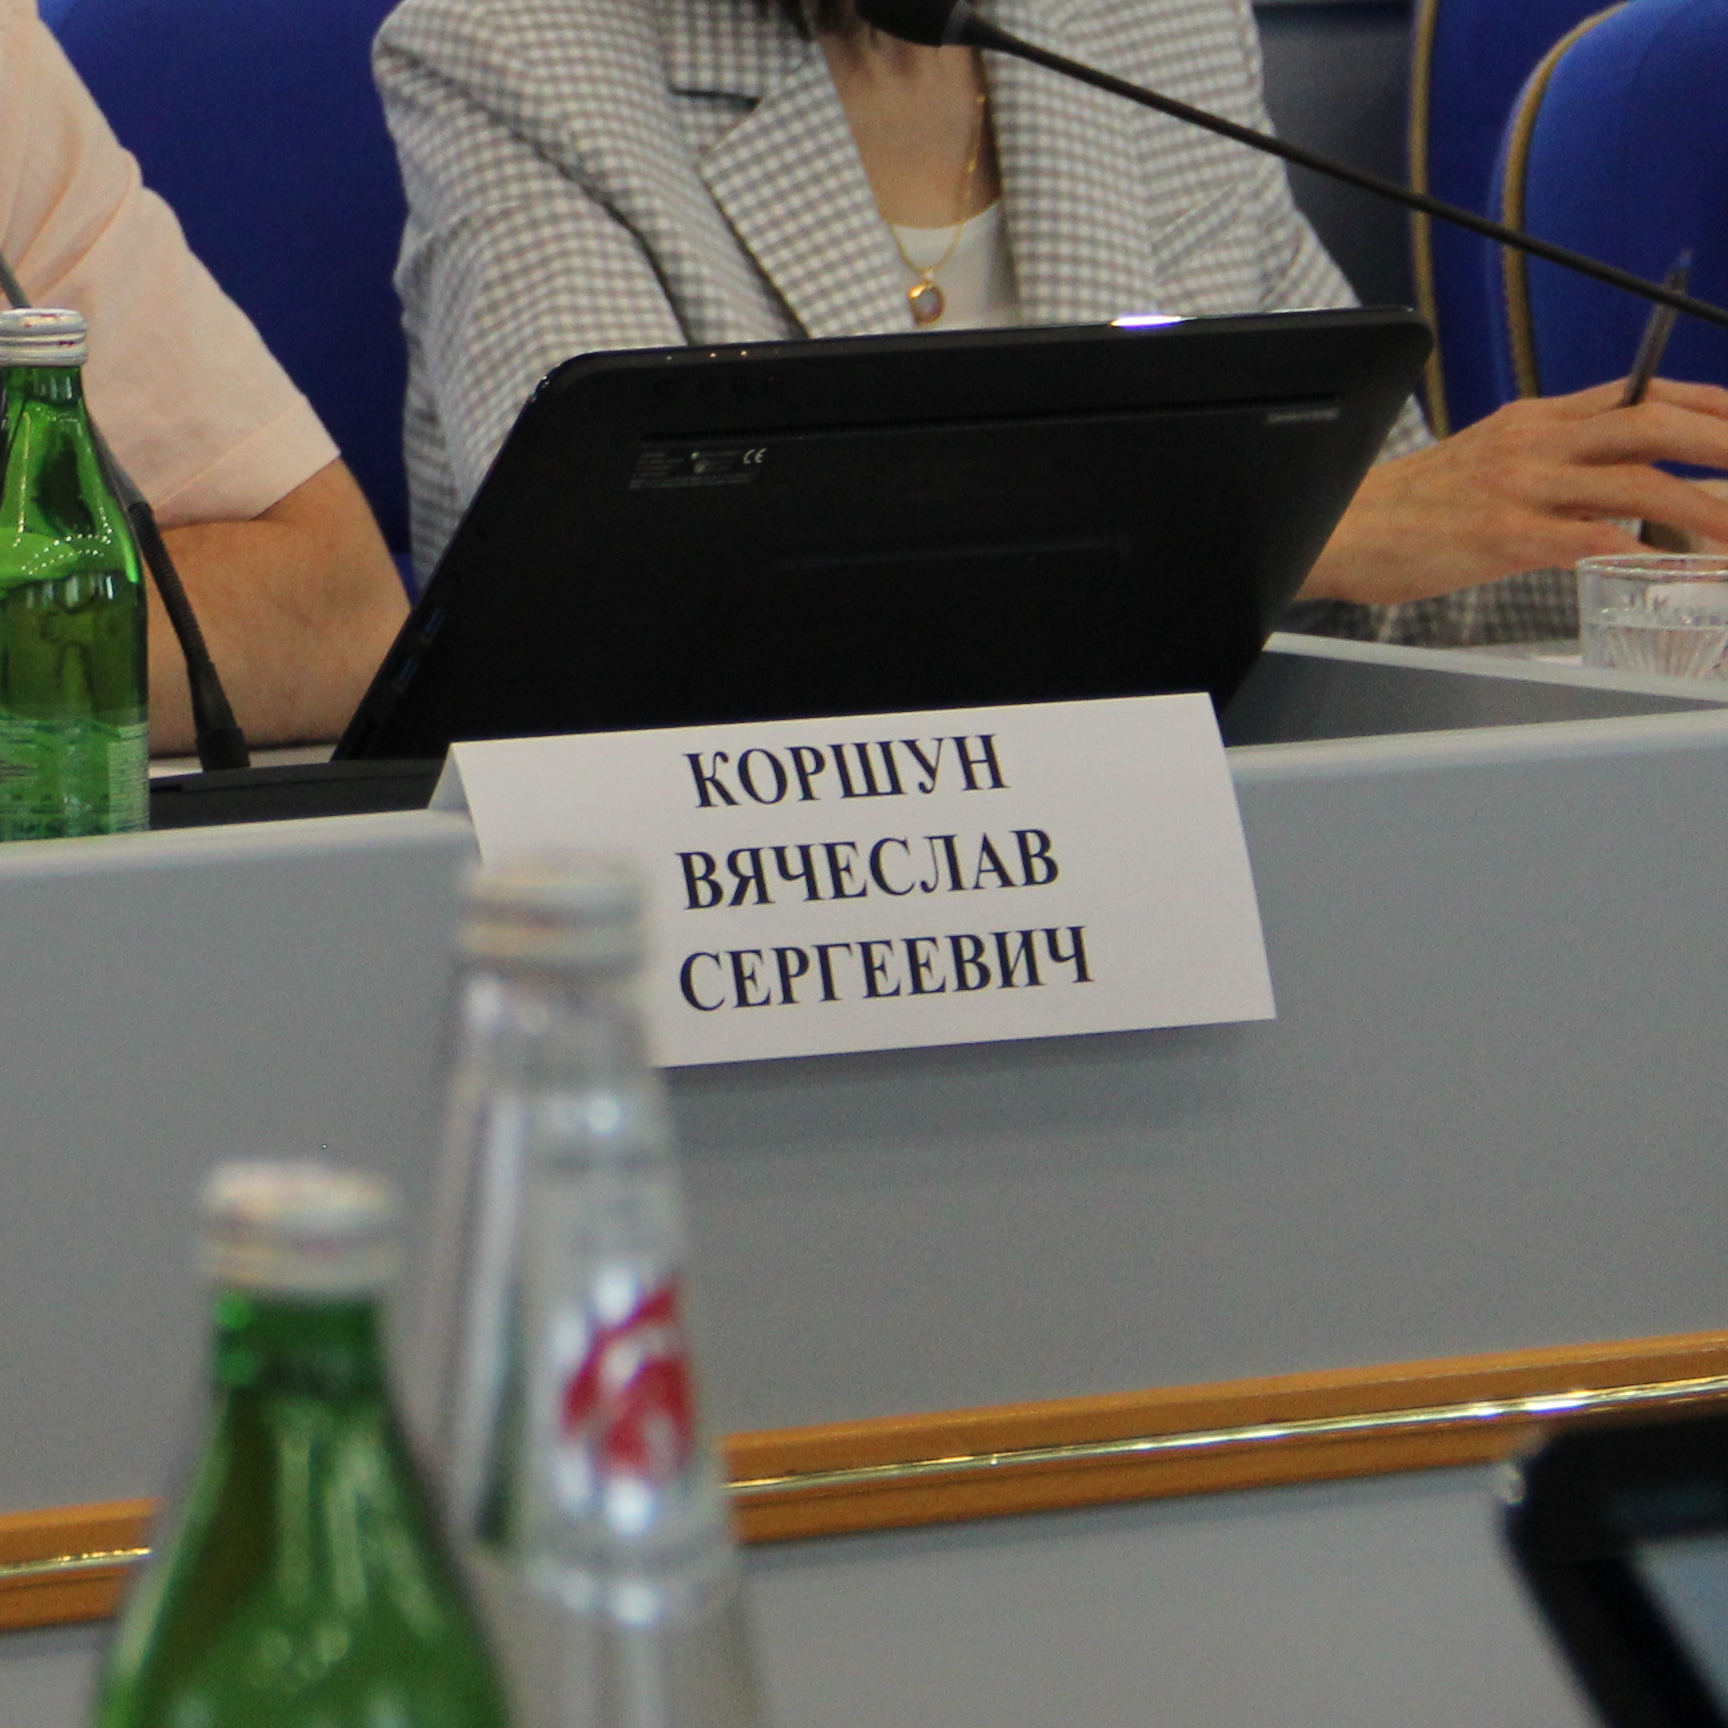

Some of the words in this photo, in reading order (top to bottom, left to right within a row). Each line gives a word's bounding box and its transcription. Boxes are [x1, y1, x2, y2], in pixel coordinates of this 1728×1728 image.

[682, 733, 1011, 809] КОРШУН
[675, 827, 1061, 912] ВЯЧЕСЛАВ
[678, 924, 1096, 1014] СЕРГЕЕВИЧ
